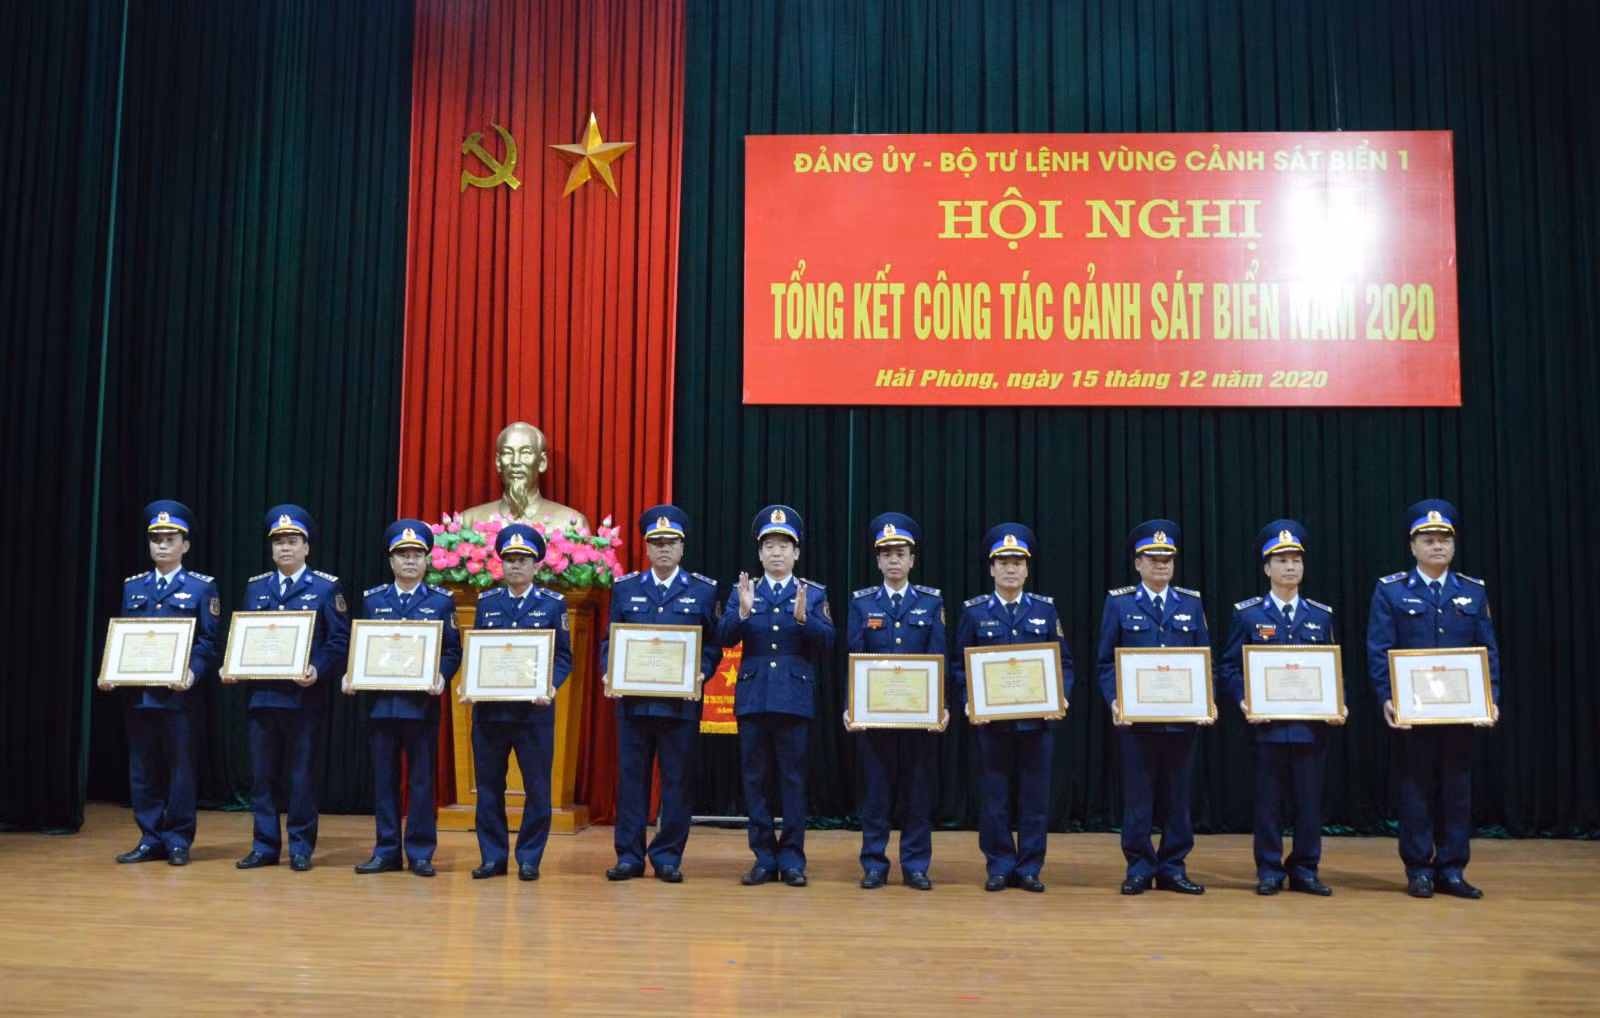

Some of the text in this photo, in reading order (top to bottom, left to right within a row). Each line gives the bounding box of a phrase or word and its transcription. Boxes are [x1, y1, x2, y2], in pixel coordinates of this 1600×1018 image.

[793, 145, 874, 173] ĐẢNG
[882, 145, 917, 173] ỦY
[939, 146, 979, 178] BỘ
[985, 149, 1018, 172] TƯ
[1025, 146, 1090, 178] LỆNH
[1098, 145, 1177, 172] VÙNG
[1184, 144, 1266, 171] CẢNH
[1273, 144, 1321, 171] SÁT
[1330, 139, 1388, 171] BIỂN
[1397, 149, 1409, 171] 1
[937, 186, 1262, 251] HỘI NGHỊ
[770, 259, 845, 341] TỔNG
[853, 263, 906, 341] KẾT
[914, 270, 992, 341] CÔNG
[1000, 270, 1054, 341] TÁC
[1063, 262, 1142, 341] CẢNH
[1151, 270, 1205, 341] SÁT
[1213, 258, 1280, 341] BIỂN
[1365, 283, 1436, 342] 2020
[875, 367, 1329, 390] Hải Phòng, ngày 15 tháng 12 năm 2020
